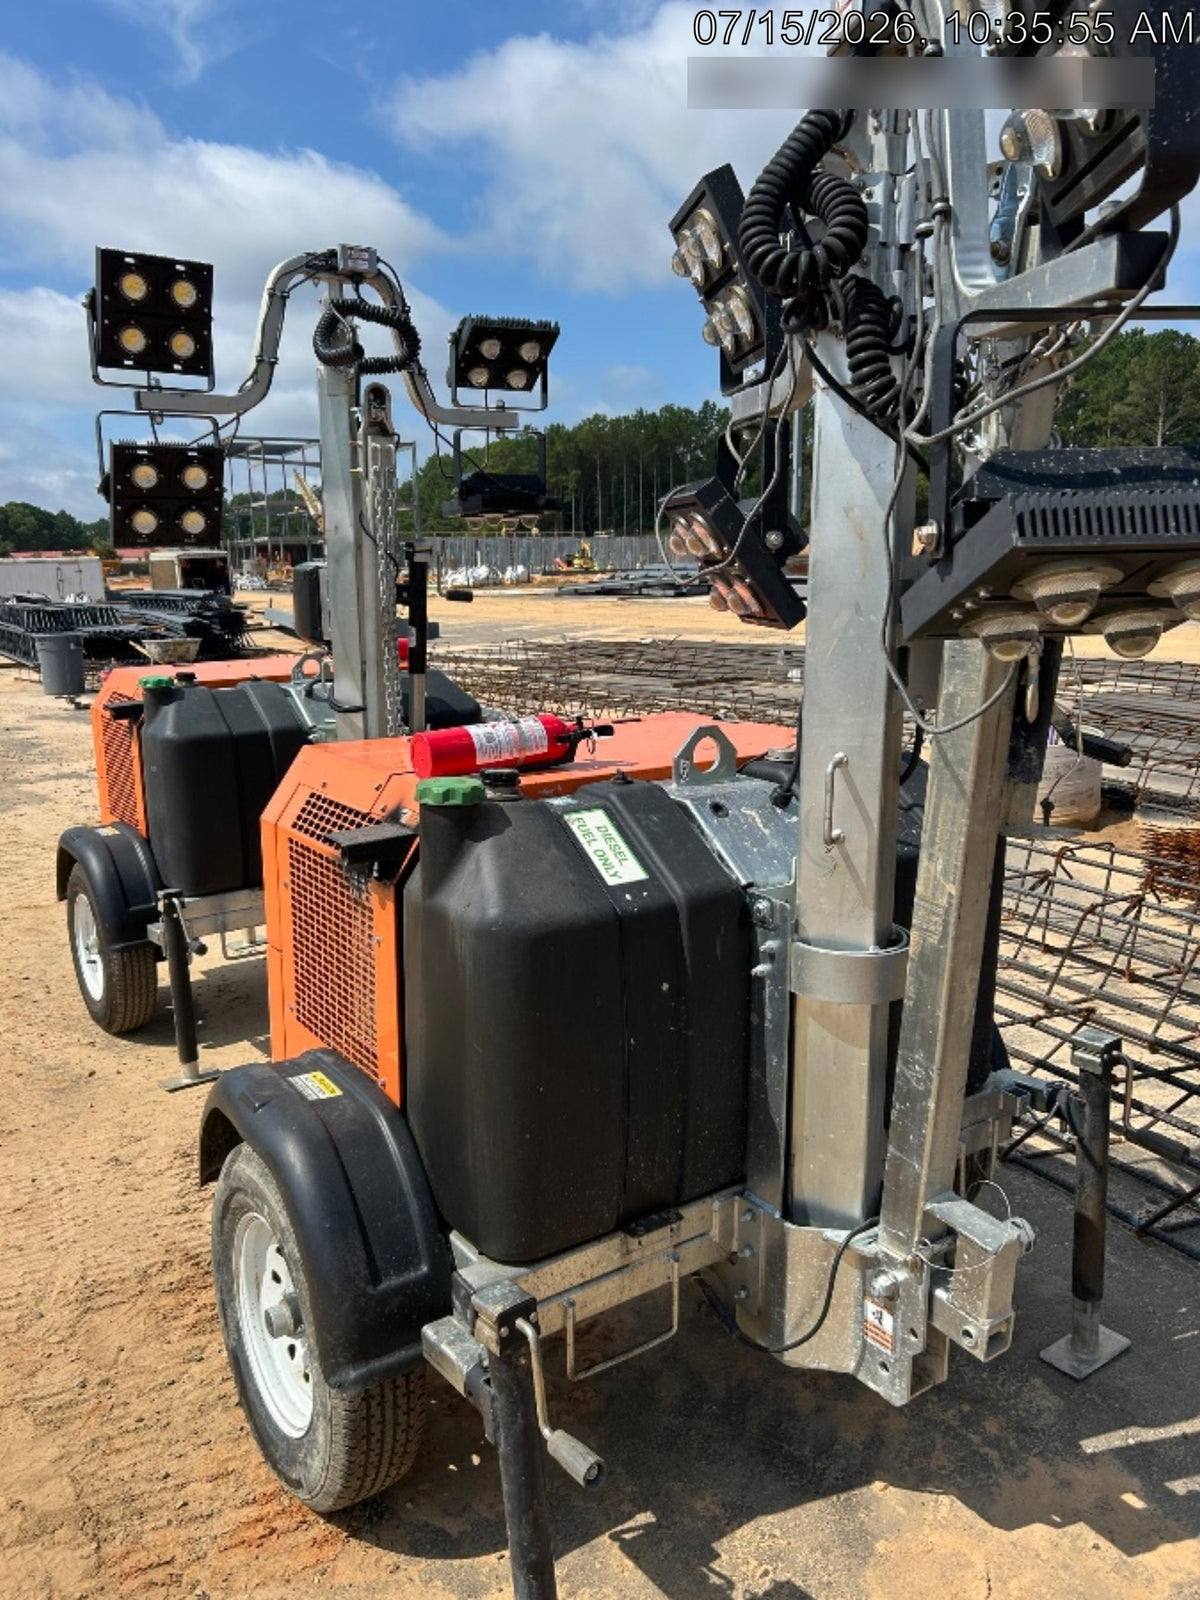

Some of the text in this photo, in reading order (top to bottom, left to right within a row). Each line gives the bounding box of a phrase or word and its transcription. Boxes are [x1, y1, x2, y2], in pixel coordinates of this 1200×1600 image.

[574, 817, 623, 879] FUEL ONLY
[596, 825, 629, 866] DIESEL
